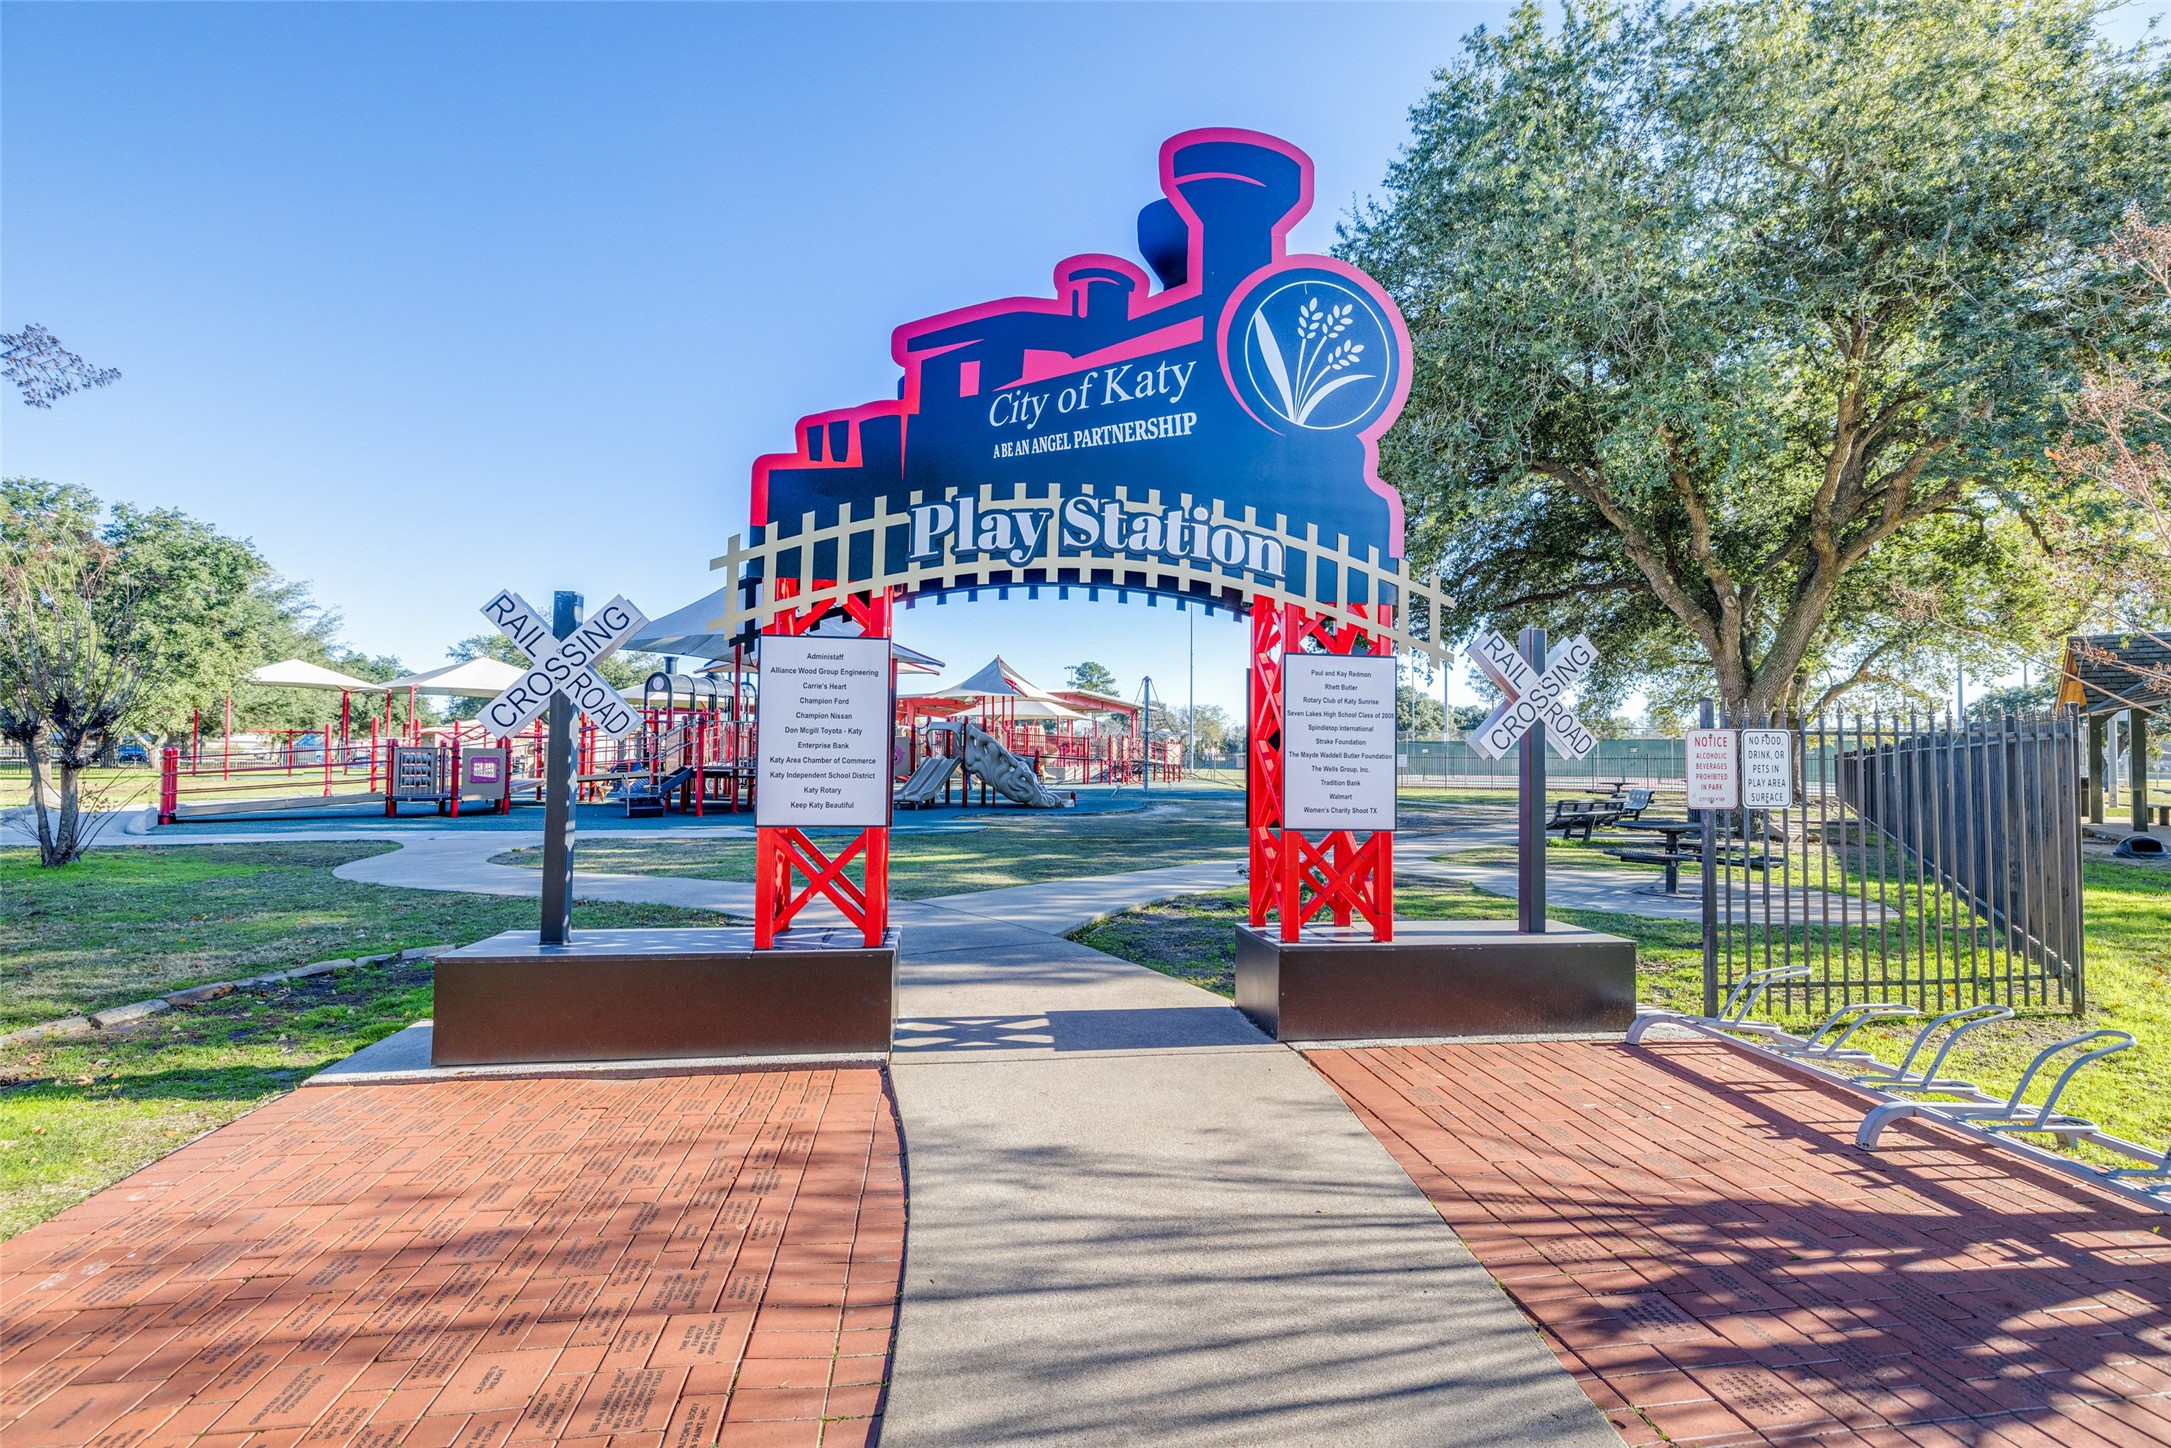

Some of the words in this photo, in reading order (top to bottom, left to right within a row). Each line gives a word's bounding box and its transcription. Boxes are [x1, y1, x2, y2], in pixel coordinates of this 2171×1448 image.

[989, 390, 1049, 430] City
[1058, 372, 1098, 413] of
[1100, 360, 1197, 405] Katy
[994, 444, 1000, 458] A
[1001, 442, 1013, 458] BE
[1014, 440, 1029, 456] AN
[1031, 432, 1072, 454] ANGEL
[1073, 412, 1198, 449] PARTNERSHIP
[909, 496, 1051, 562] Play
[1063, 496, 1286, 577] Station
[485, 594, 545, 658] RAIL
[566, 672, 630, 734] ROAD
[491, 606, 630, 727] CROSSING
[818, 668, 839, 676] Group
[840, 668, 879, 678] Engineering
[1483, 635, 1527, 690] RAIL
[1544, 701, 1592, 754] ROAD
[1491, 645, 1591, 750] CROSSING
[799, 697, 833, 705] Champion
[1303, 696, 1321, 704] Rotary
[1344, 698, 1356, 706] Katy
[796, 712, 829, 720] Champion
[1323, 711, 1336, 719] High
[800, 727, 819, 735] Mcgill
[821, 727, 842, 735] Toyota
[848, 728, 863, 736] Katy
[1308, 724, 1338, 732] Spindletop
[798, 741, 831, 750] Enterprise
[1695, 736, 1727, 747] NOTICE
[1749, 736, 1759, 745] NO
[1761, 736, 1783, 746] FOOD,
[1300, 751, 1319, 759] Mayde
[1748, 750, 1772, 760] DRINK,
[1774, 750, 1785, 759] OR
[769, 756, 785, 765] Katy
[803, 756, 832, 764] Chamber
[1752, 764, 1769, 773] PETS
[1772, 764, 1779, 773] IN
[770, 771, 785, 780] Katy
[1748, 778, 1766, 787] PLAY
[1767, 778, 1786, 787] AREA
[804, 787, 819, 795] Katy
[820, 787, 842, 795] Rotary
[1751, 793, 1783, 802] SURFACE
[790, 801, 807, 810] Keep
[809, 802, 824, 810] Katy
[1330, 807, 1351, 815] Charity
